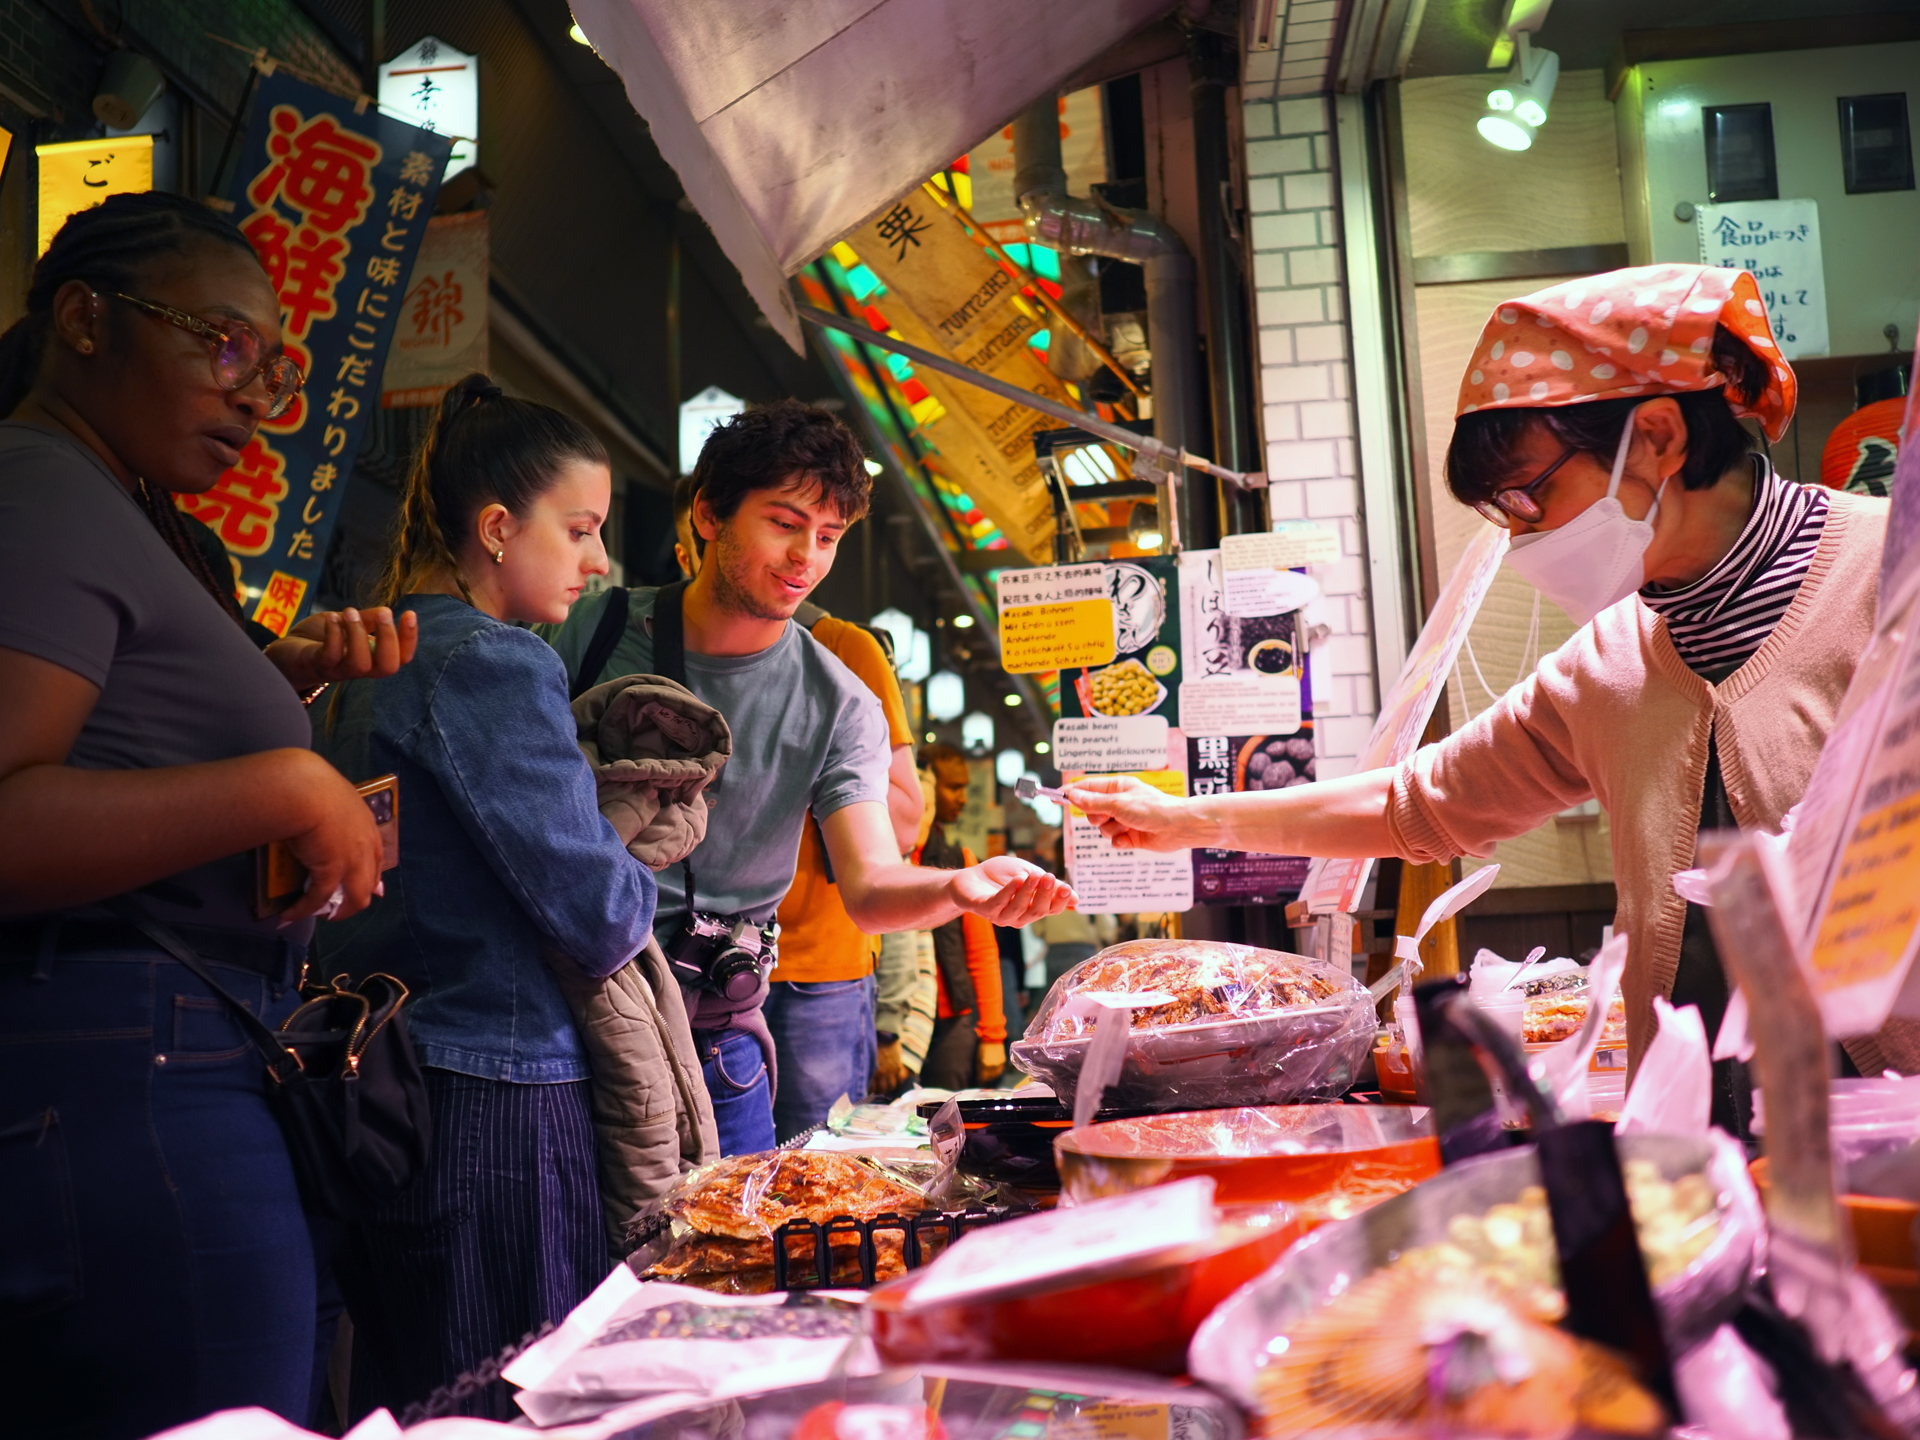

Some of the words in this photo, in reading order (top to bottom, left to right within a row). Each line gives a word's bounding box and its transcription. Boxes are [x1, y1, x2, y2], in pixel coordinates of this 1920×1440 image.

[1711, 215, 1810, 247] 食品につき
[163, 307, 210, 336] FENDI
[287, 151, 434, 560] 素材と味にこだわりました
[1004, 610, 1033, 618] Wasabi
[1041, 606, 1074, 615] Bohnen
[1006, 634, 1057, 644] Anhaltende
[1058, 723, 1089, 731] Wasabi
[1092, 722, 1118, 731] beans
[1058, 736, 1079, 744] With
[1082, 735, 1119, 744] peanuts
[1058, 748, 1103, 758] Lingering
[1106, 747, 1167, 756] deliciousness
[1060, 761, 1103, 771] Addictive
[1106, 761, 1148, 772] spiciness
